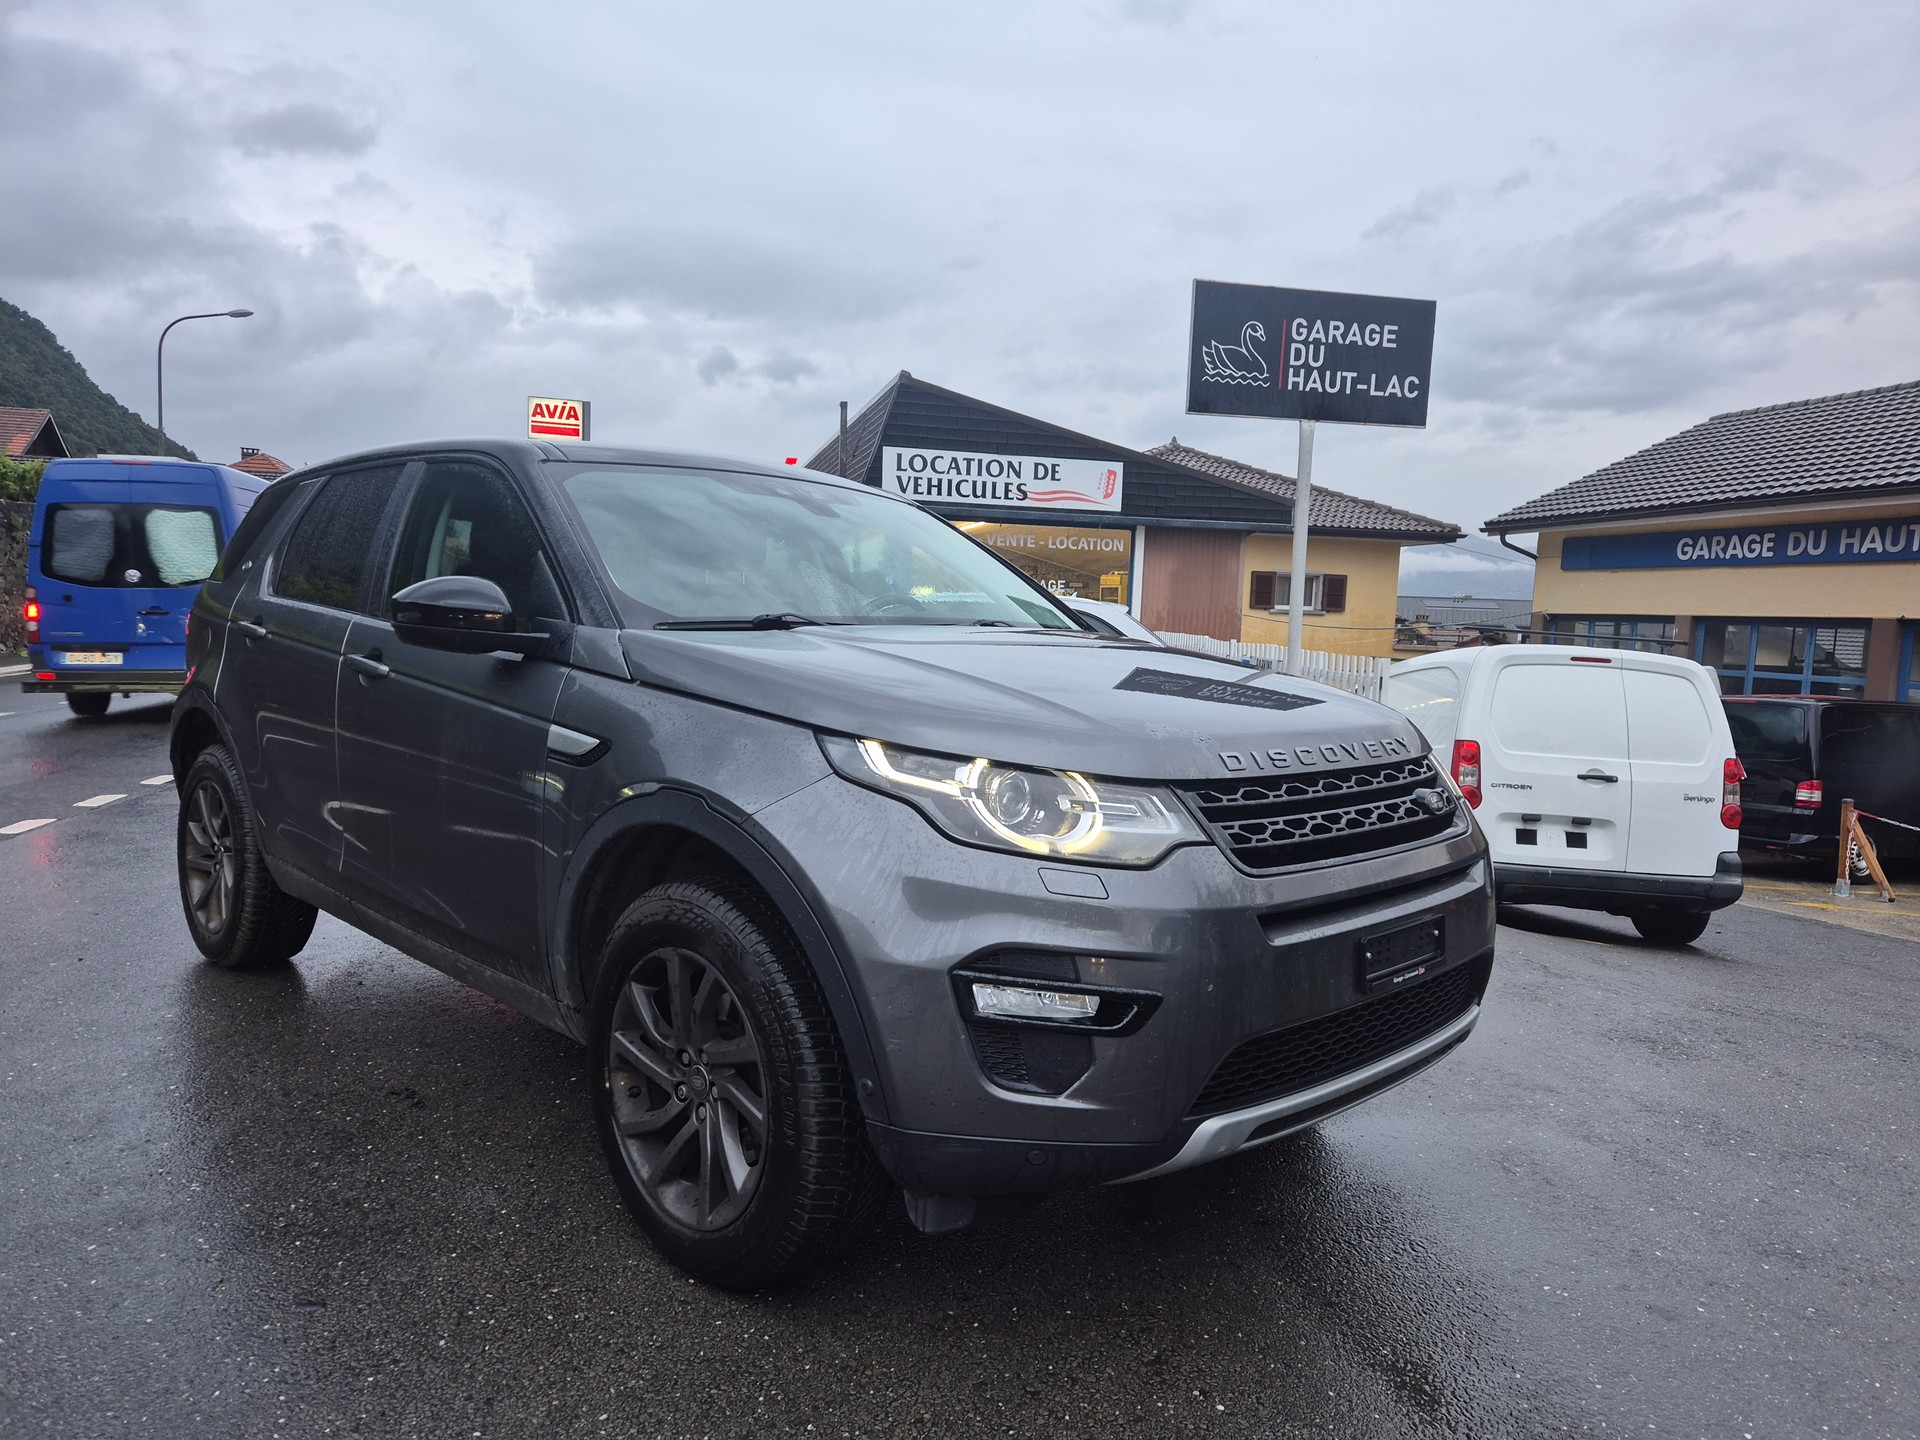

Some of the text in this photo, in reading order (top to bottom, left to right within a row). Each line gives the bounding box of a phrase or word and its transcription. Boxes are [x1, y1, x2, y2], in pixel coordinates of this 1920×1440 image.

[1291, 317, 1399, 348] GARAGE
[1289, 342, 1325, 367] DU
[1287, 367, 1420, 399] HAUT-LAC
[896, 452, 1062, 482] LOCATION DE
[895, 475, 1028, 501] VEHICULES
[985, 534, 1036, 548] VENTE
[1048, 536, 1124, 551] LOCATION
[1676, 532, 1776, 561] GARAGE
[1787, 528, 1828, 556] DU
[1040, 579, 1066, 592] AGE
[1218, 736, 1411, 772] DISCOVERY
